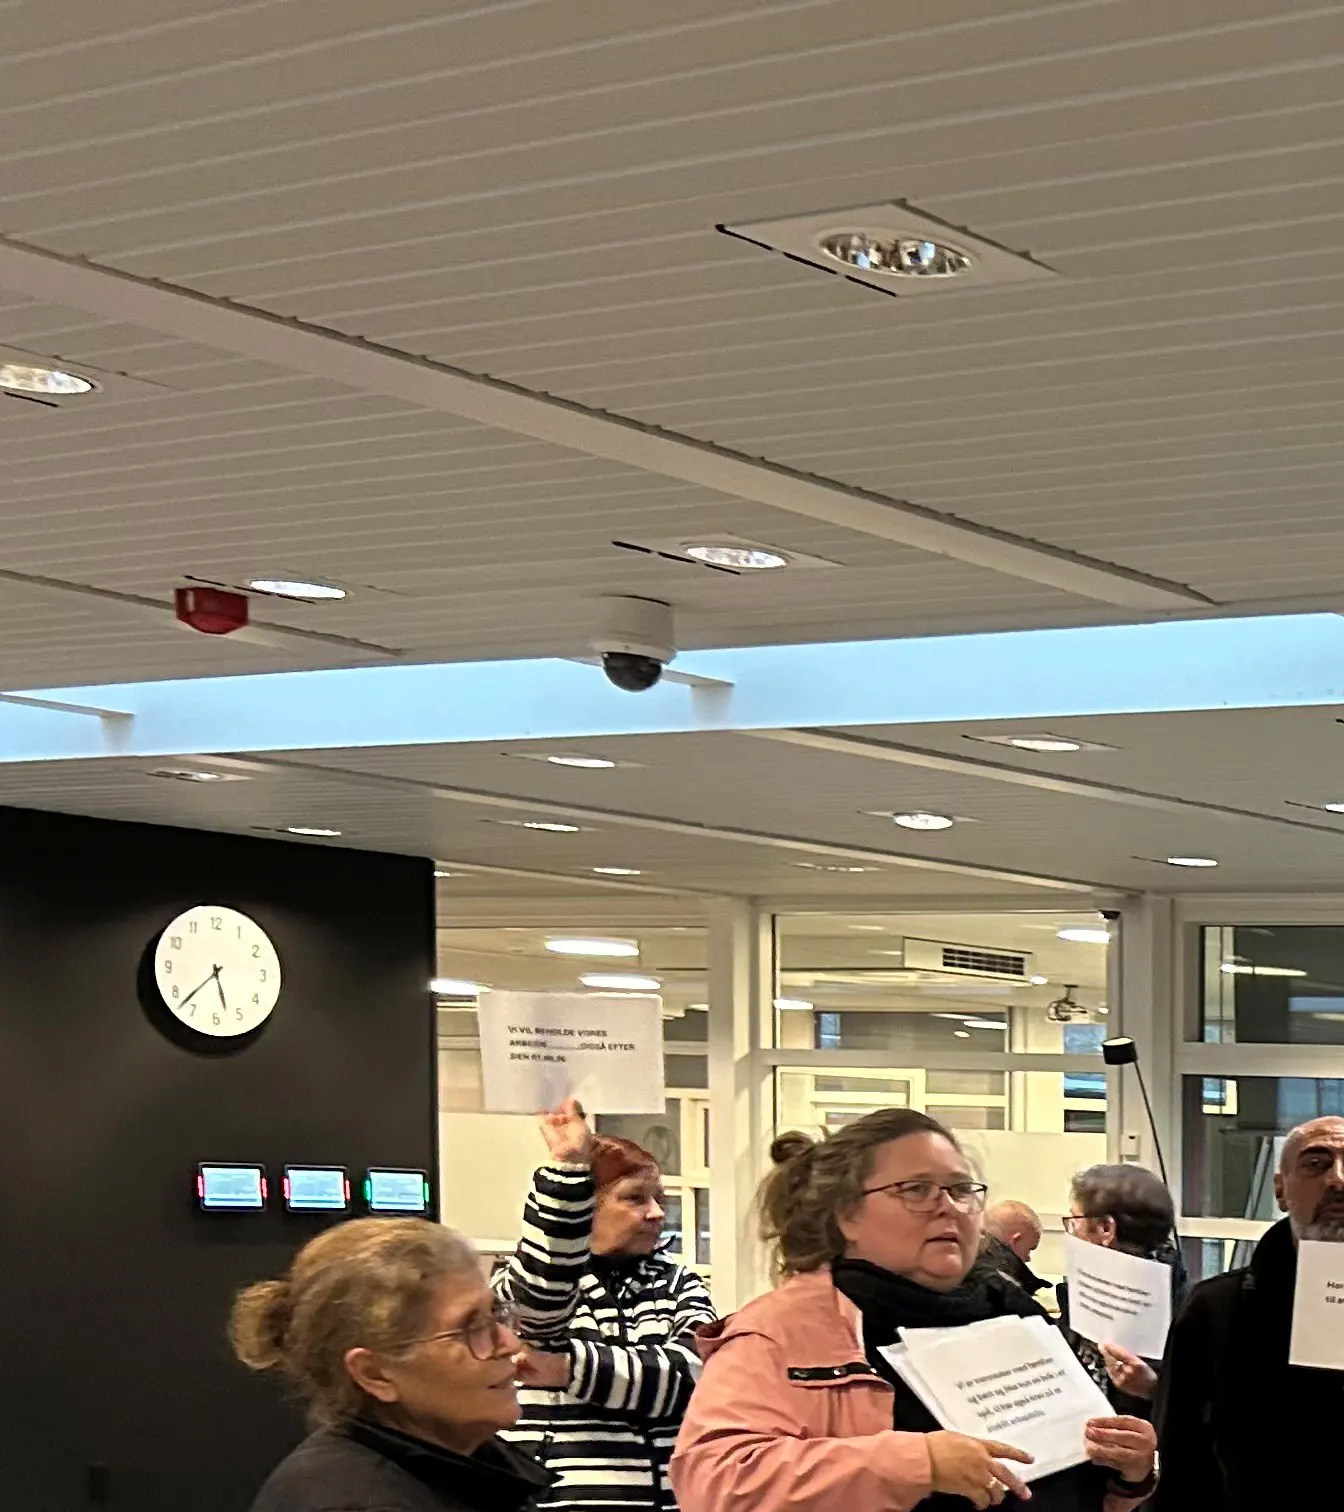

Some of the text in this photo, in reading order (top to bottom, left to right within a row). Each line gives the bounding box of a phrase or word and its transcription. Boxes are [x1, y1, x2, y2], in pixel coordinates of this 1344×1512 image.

[189, 921, 198, 934] 11
[210, 916, 223, 931] 12
[236, 925, 242, 940] 1
[170, 936, 183, 951] 10
[251, 944, 260, 958] 2
[164, 960, 173, 974] 9
[259, 969, 267, 983] 3
[172, 984, 180, 999] 8
[251, 992, 260, 1006] 4
[189, 1003, 197, 1017] 7
[235, 1007, 243, 1021] 5
[212, 1012, 220, 1026] 6
[1327, 1281, 1344, 1290] Har
